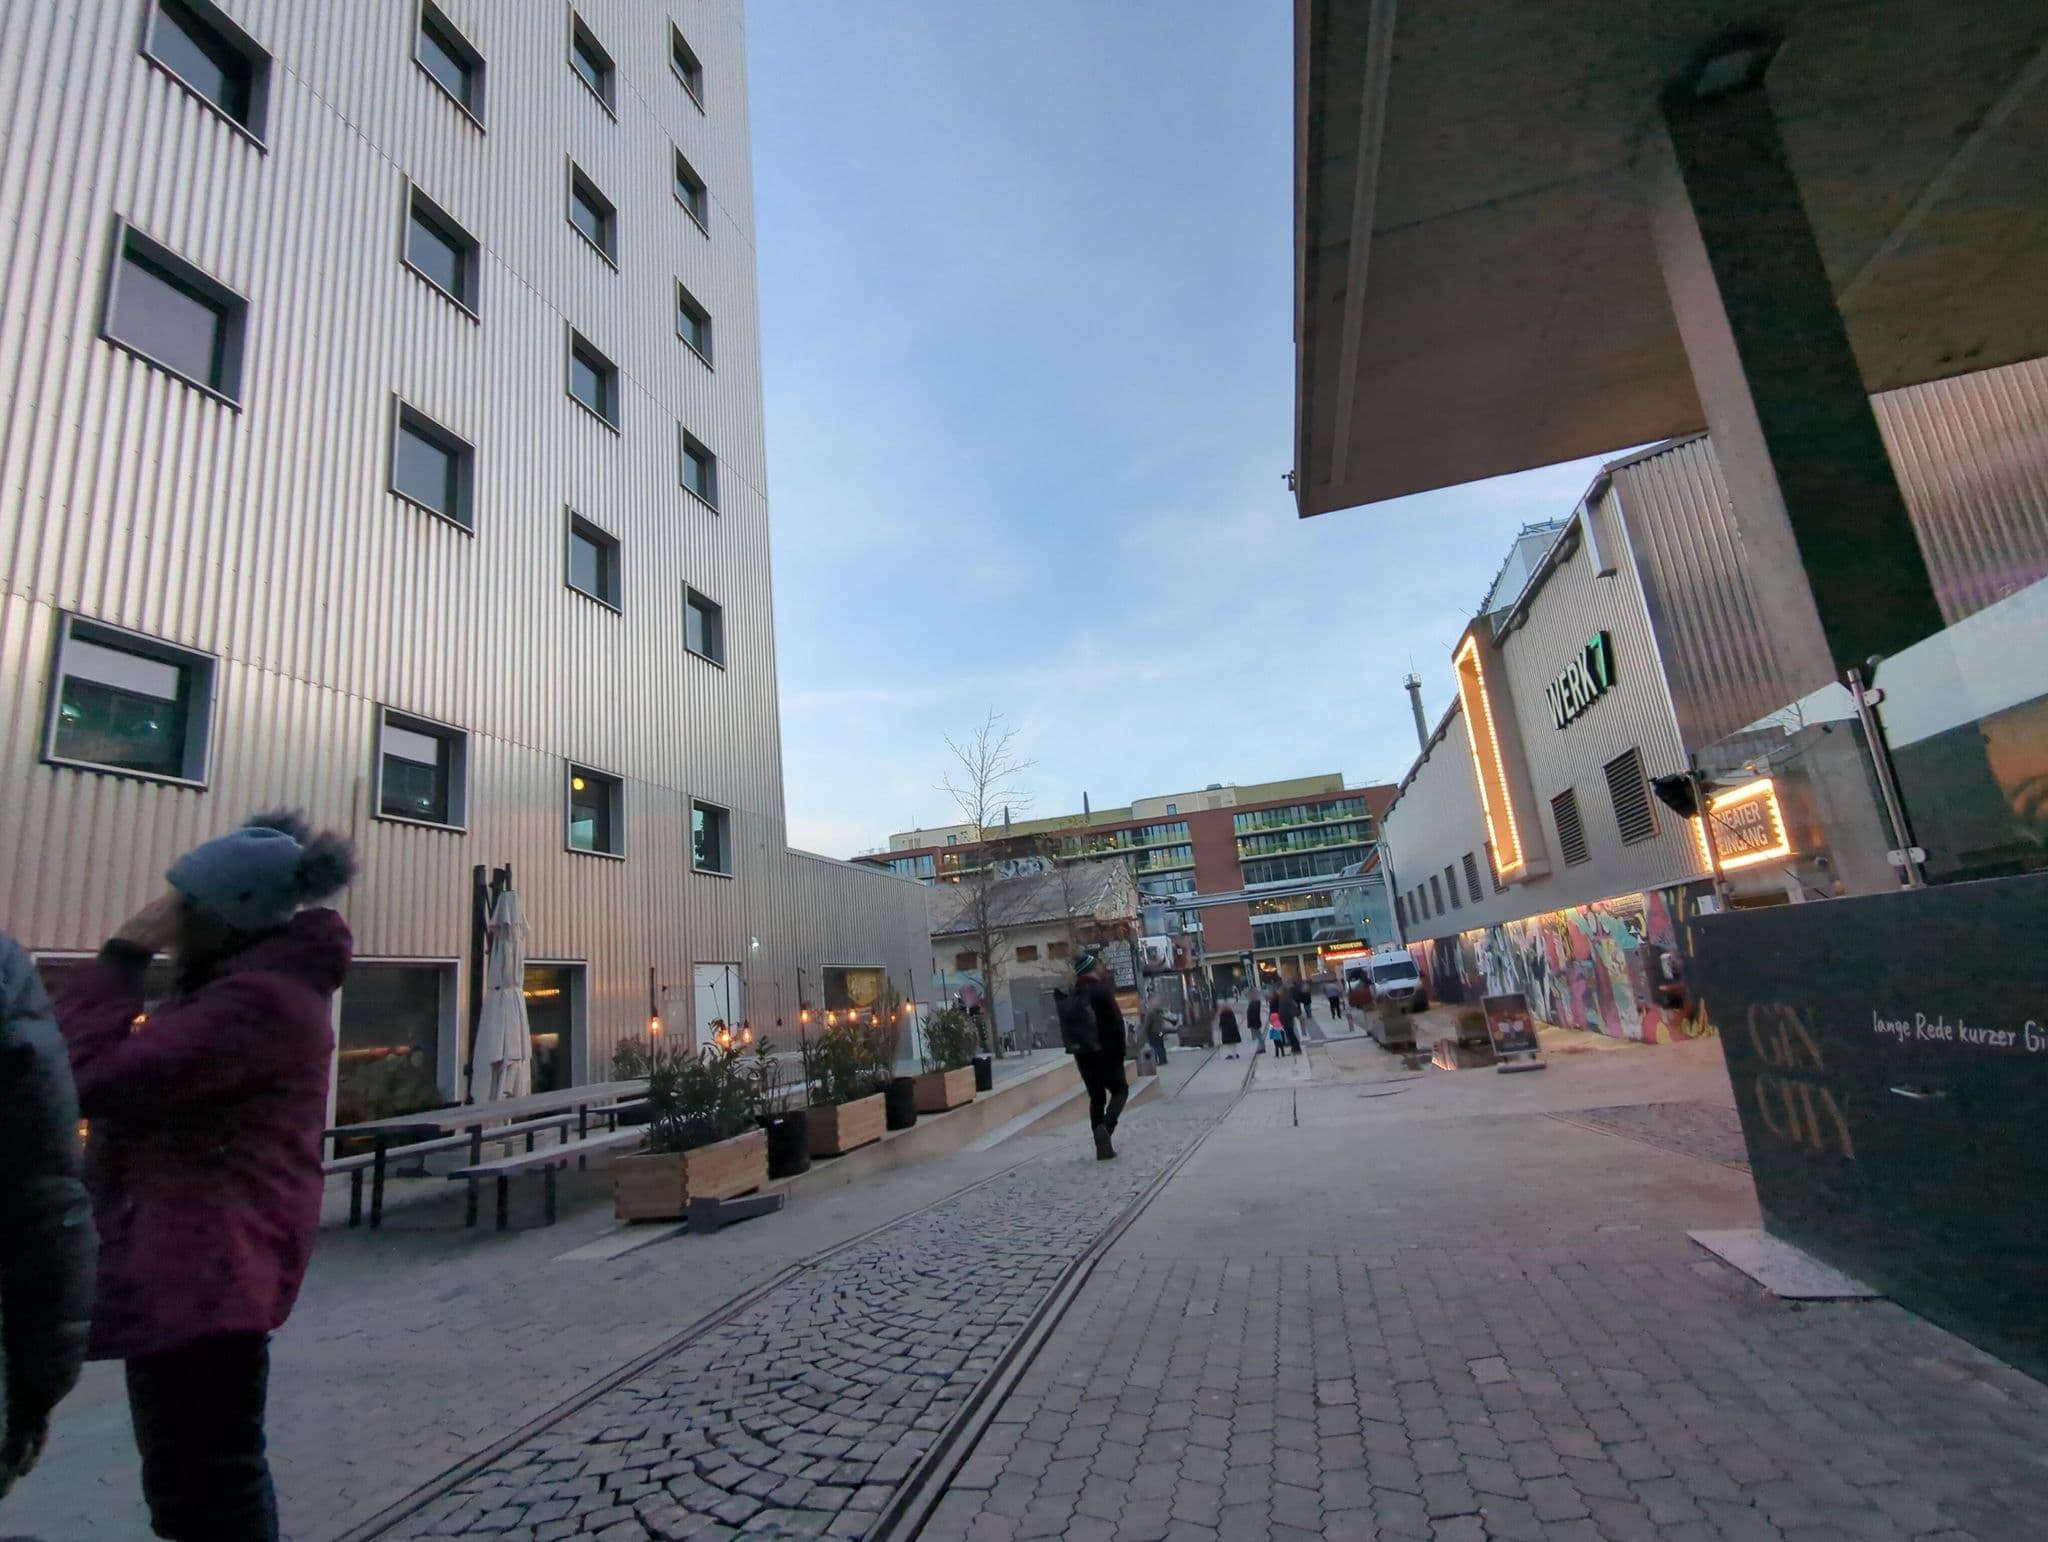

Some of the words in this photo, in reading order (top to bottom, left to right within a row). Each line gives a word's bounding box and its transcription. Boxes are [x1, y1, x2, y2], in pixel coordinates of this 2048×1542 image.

[1716, 825, 1769, 856] EINGANG
[1872, 1009, 1911, 1043] lange
[1915, 1012, 1954, 1042] Rede
[1959, 1019, 2017, 1048] kurzer
[2024, 1020, 2048, 1053] Gi
